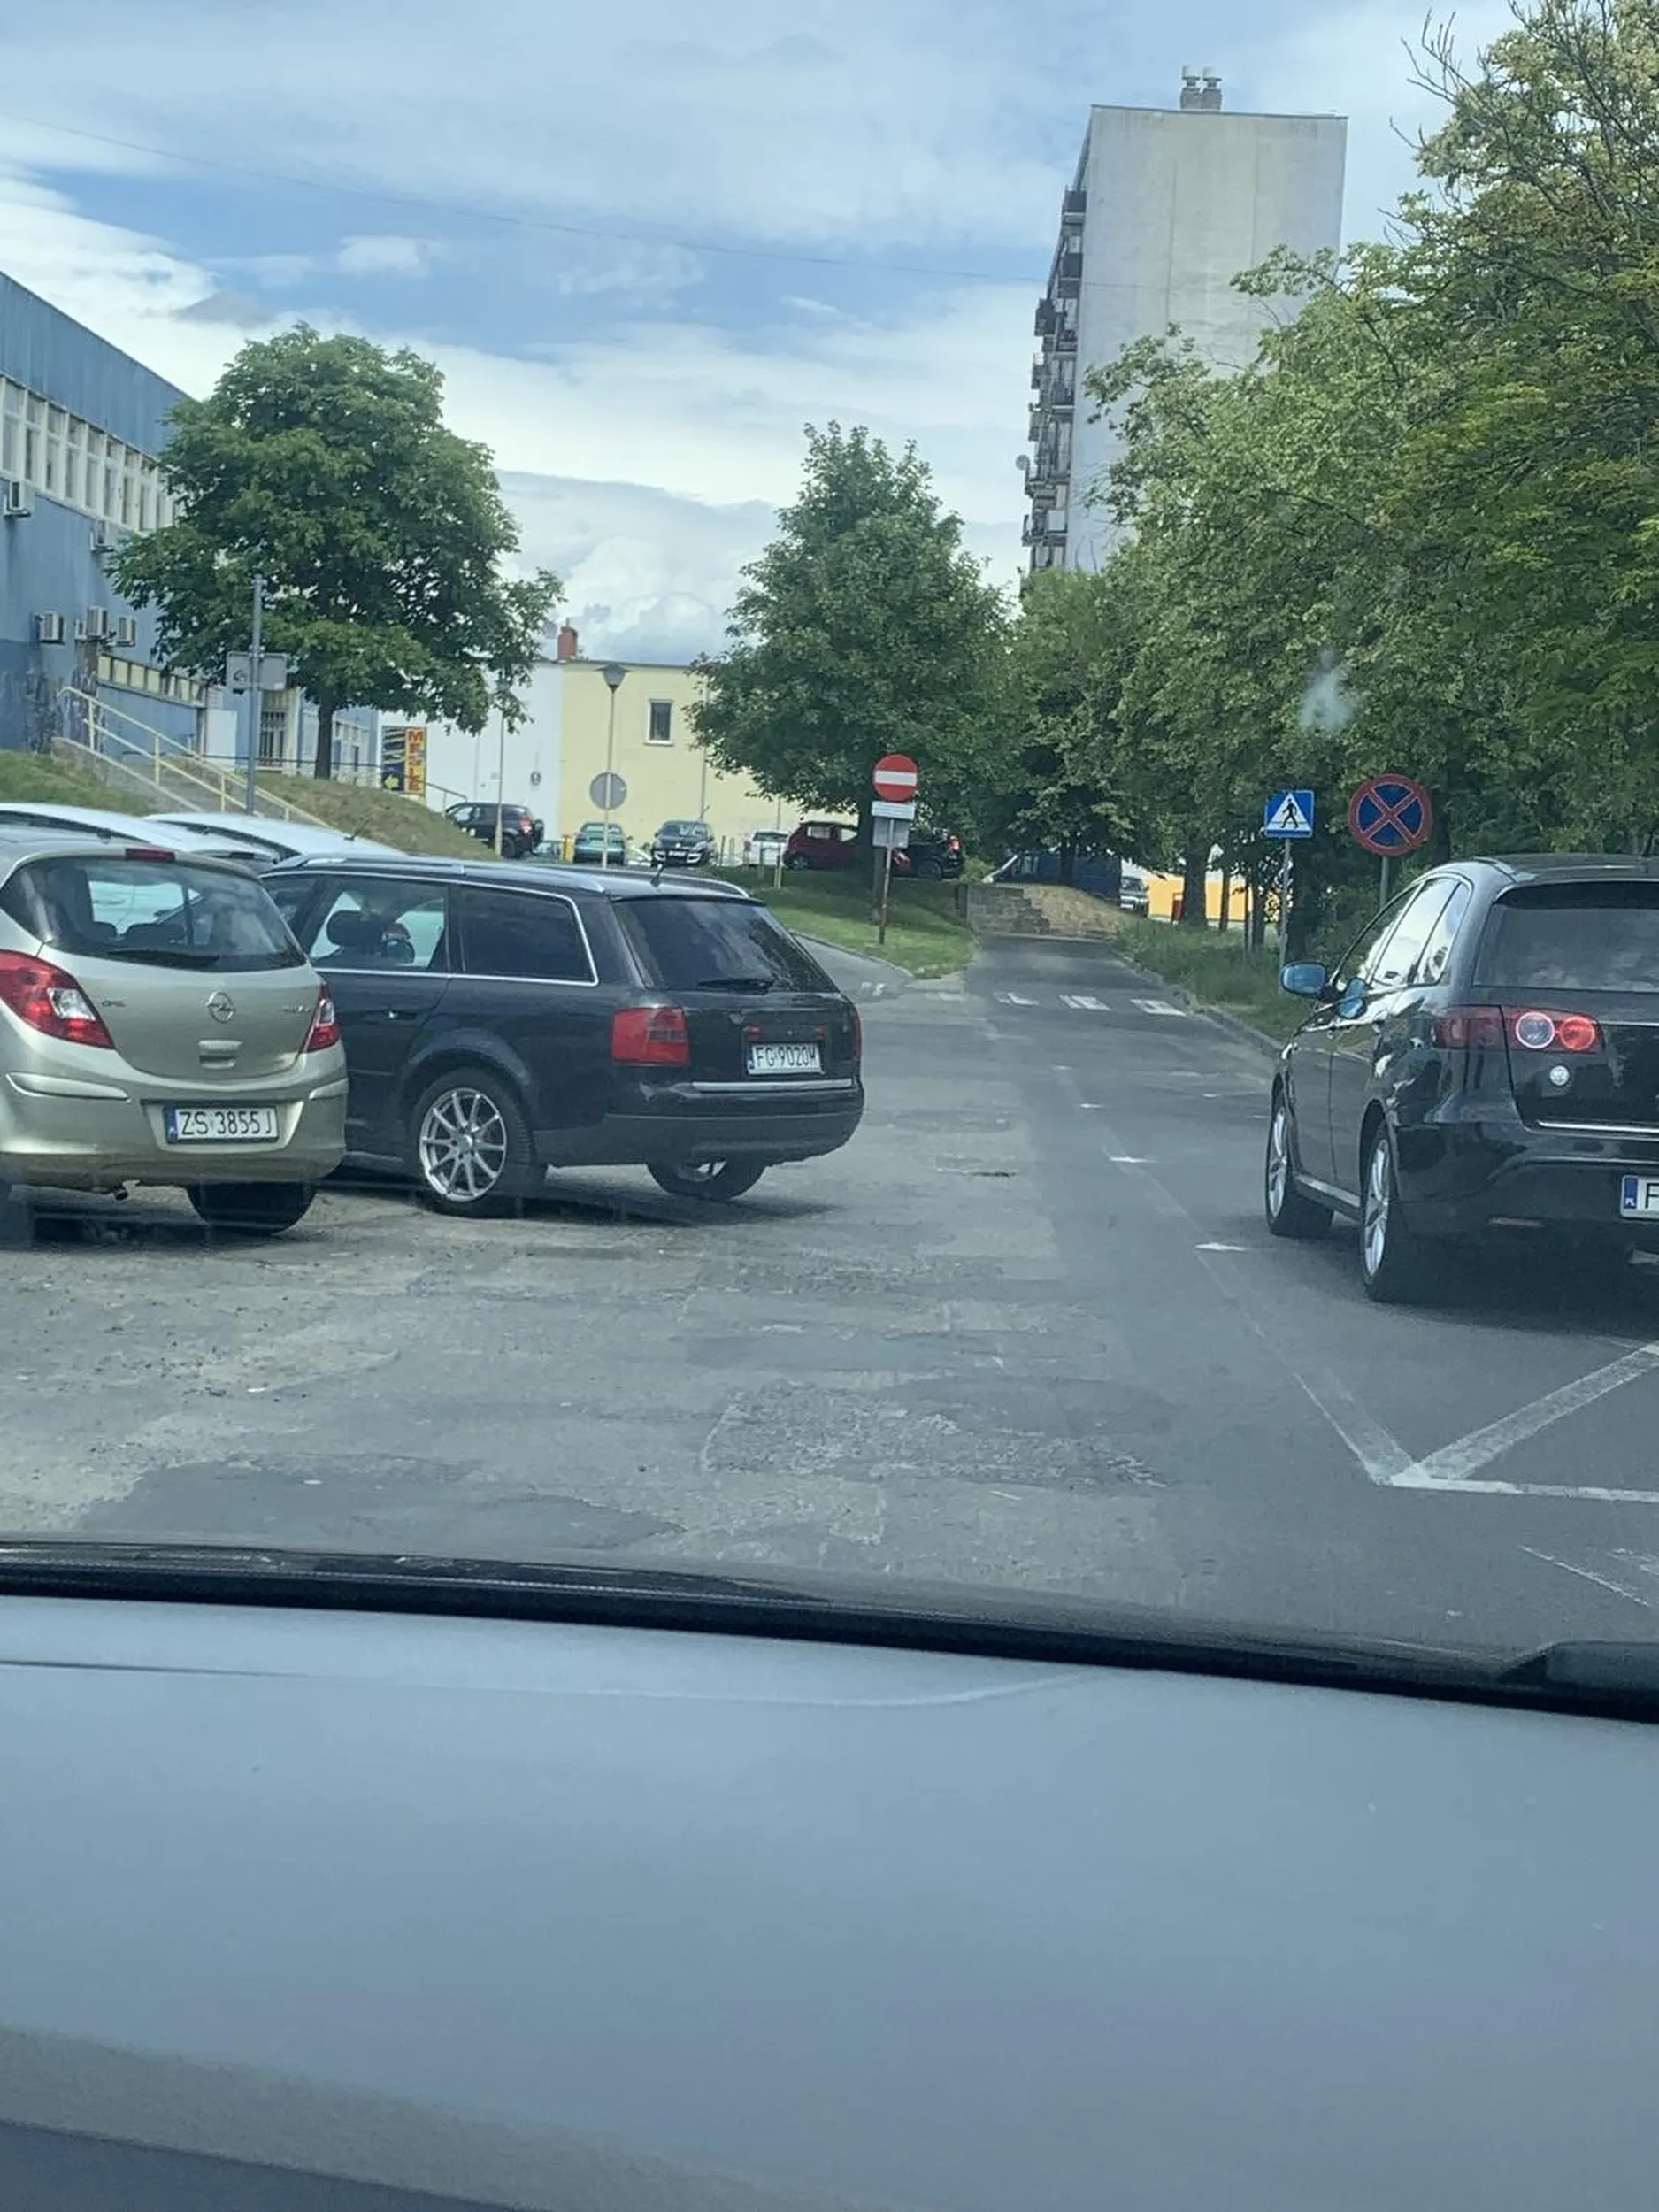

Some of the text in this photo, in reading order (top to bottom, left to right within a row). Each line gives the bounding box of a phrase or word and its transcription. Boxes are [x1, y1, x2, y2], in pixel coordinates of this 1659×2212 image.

[757, 1047, 775, 1067] FG
[179, 1110, 271, 1135] ZS 3855J
